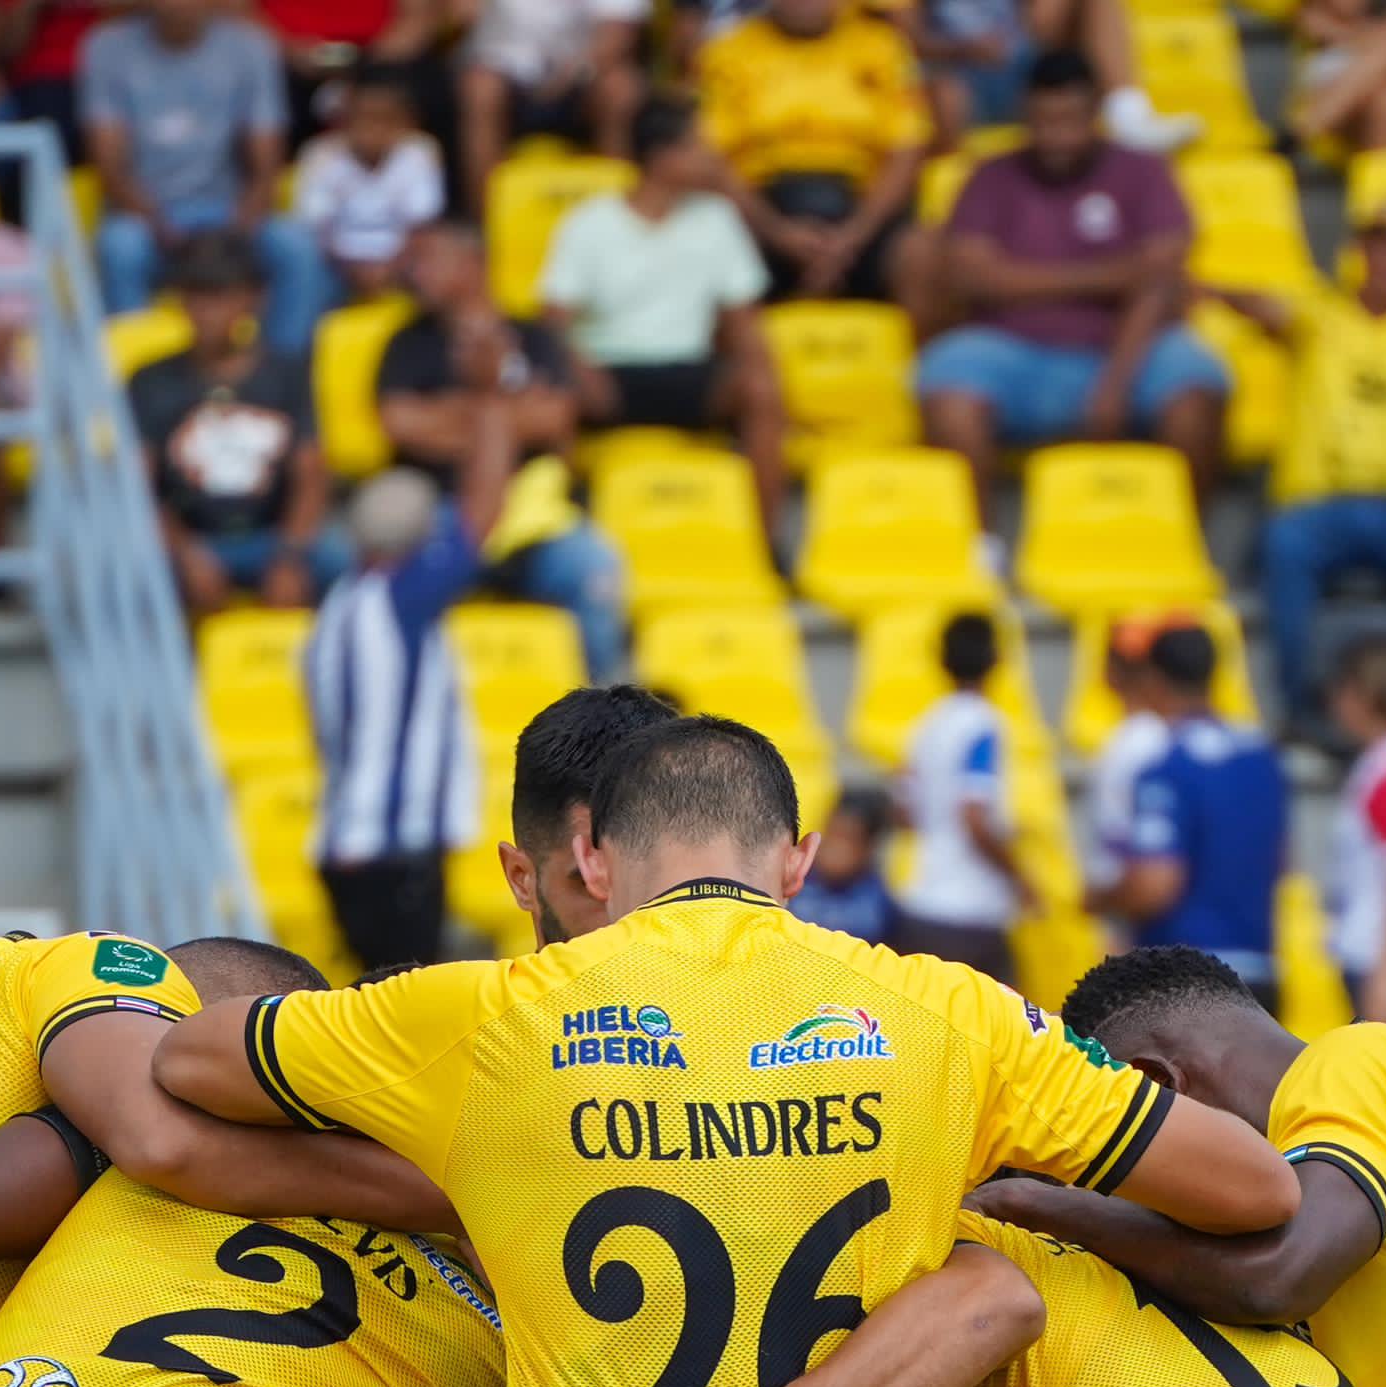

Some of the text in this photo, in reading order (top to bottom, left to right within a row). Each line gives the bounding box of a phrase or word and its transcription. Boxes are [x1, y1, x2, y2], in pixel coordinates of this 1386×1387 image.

[692, 883, 740, 898] LIBERIA
[552, 1036, 687, 1070] LIBERIA
[749, 1032, 891, 1069] Electrolit
[570, 1091, 883, 1161] COLINDRES
[97, 1222, 361, 1384] 2
